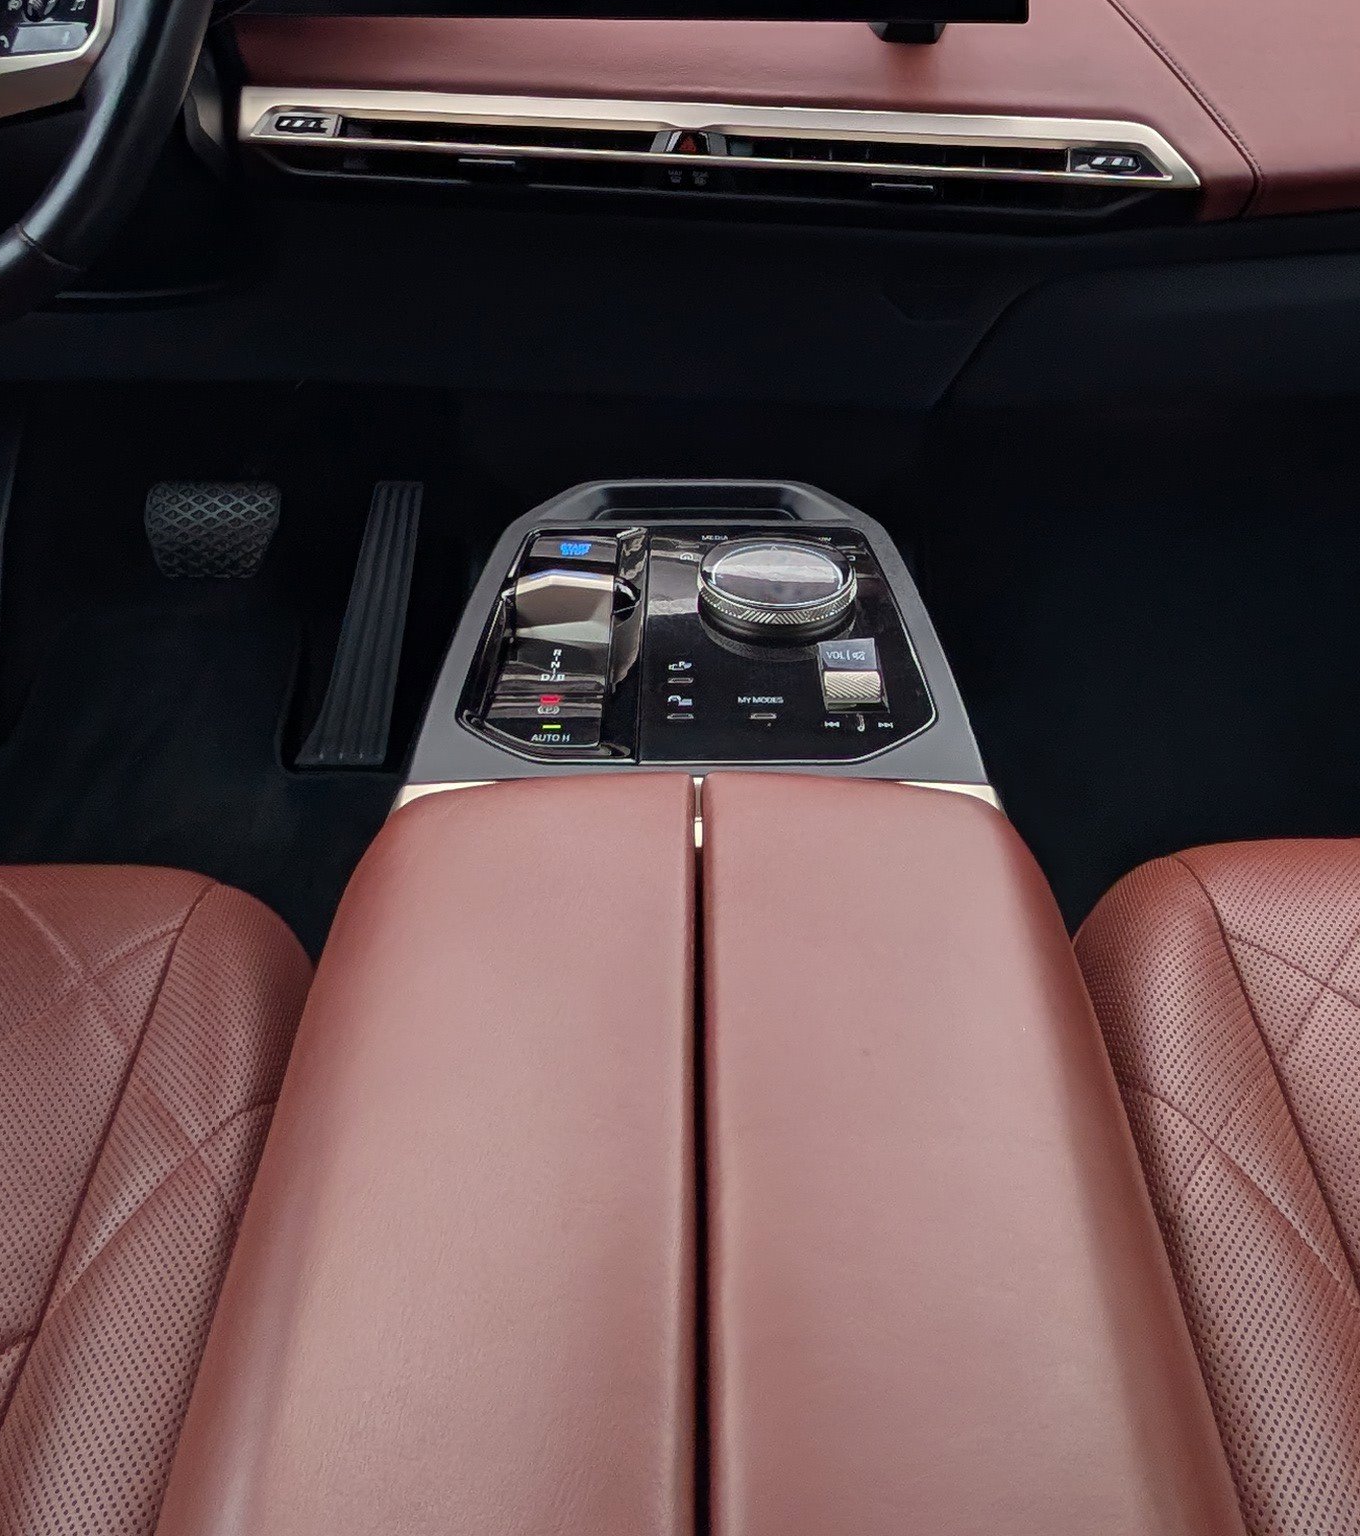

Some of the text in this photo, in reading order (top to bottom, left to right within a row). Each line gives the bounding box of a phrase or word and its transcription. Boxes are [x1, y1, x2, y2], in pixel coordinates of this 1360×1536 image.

[825, 650, 847, 661] VOL
[530, 733, 572, 742] AUTO H
